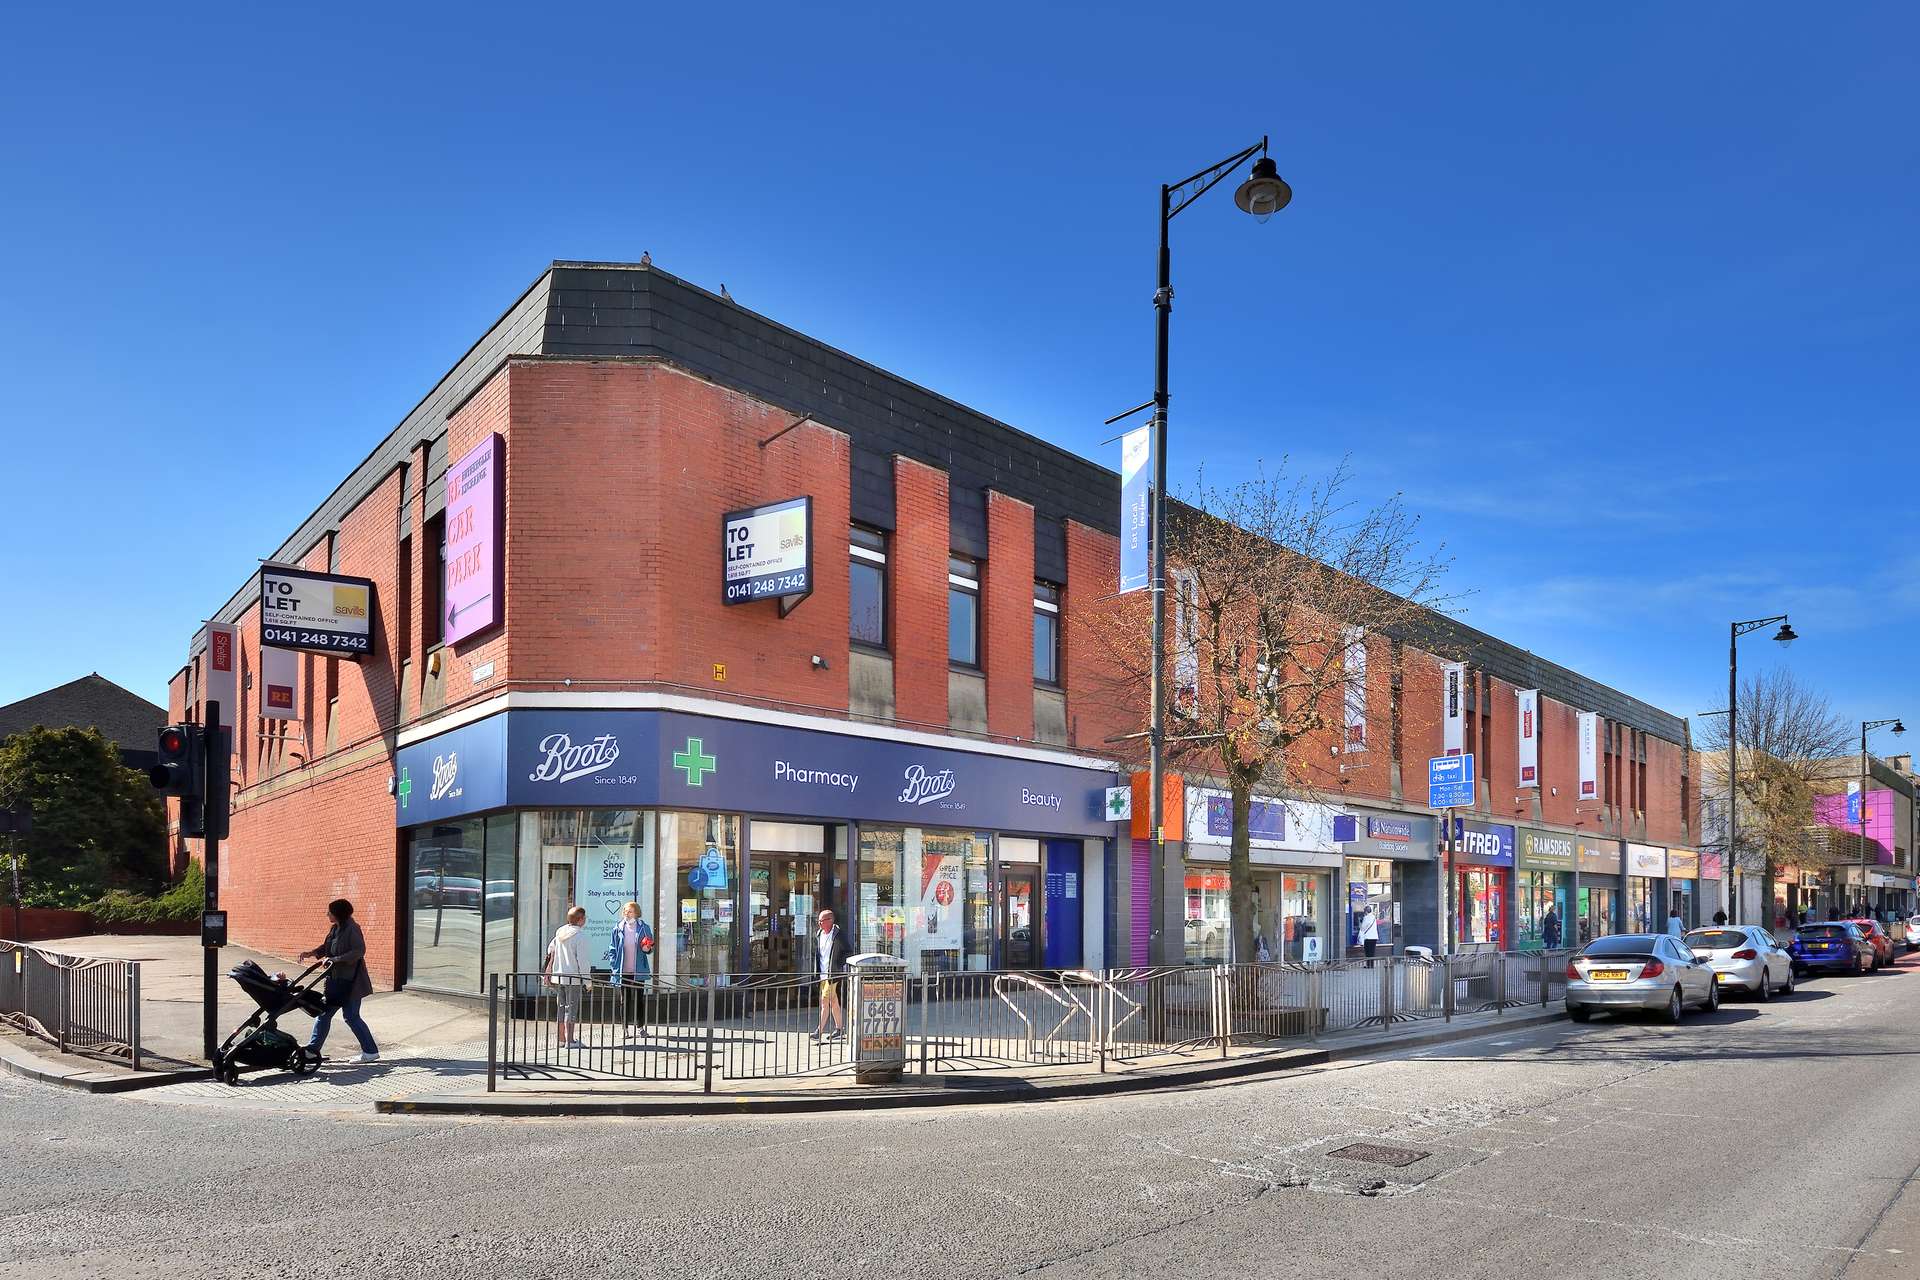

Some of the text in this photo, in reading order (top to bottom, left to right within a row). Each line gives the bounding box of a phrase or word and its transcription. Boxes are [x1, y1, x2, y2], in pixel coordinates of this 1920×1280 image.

[447, 504, 475, 546] CAR
[728, 526, 749, 544] TO
[780, 534, 804, 549] savills
[728, 544, 755, 562] LET
[447, 541, 483, 591] PARK
[727, 557, 783, 572] SELF-CONTAINED OFFICE
[265, 580, 293, 595] TO
[727, 574, 805, 598] 0141 248 7342
[265, 596, 301, 611] LET
[335, 605, 365, 616] savills
[265, 612, 338, 625] SELF-CONTAINED OFFICE
[264, 629, 367, 648] 0141 248 7342
[216, 635, 228, 667] Shelter
[271, 690, 290, 702] RE
[529, 733, 620, 784] Boots
[429, 750, 458, 800] Boots
[594, 775, 638, 785] Since 1849
[774, 760, 858, 792] Pharmacy
[897, 764, 956, 806] Boots
[939, 801, 953, 810] Since
[1021, 788, 1062, 812] Beauty
[1533, 837, 1571, 857] RAMSDENS
[603, 860, 625, 870] Shop
[603, 869, 623, 878] Safe
[588, 889, 601, 897] Stay
[867, 1001, 896, 1018] 649
[863, 1017, 900, 1034] 7777
[863, 1039, 900, 1049] TAXI
